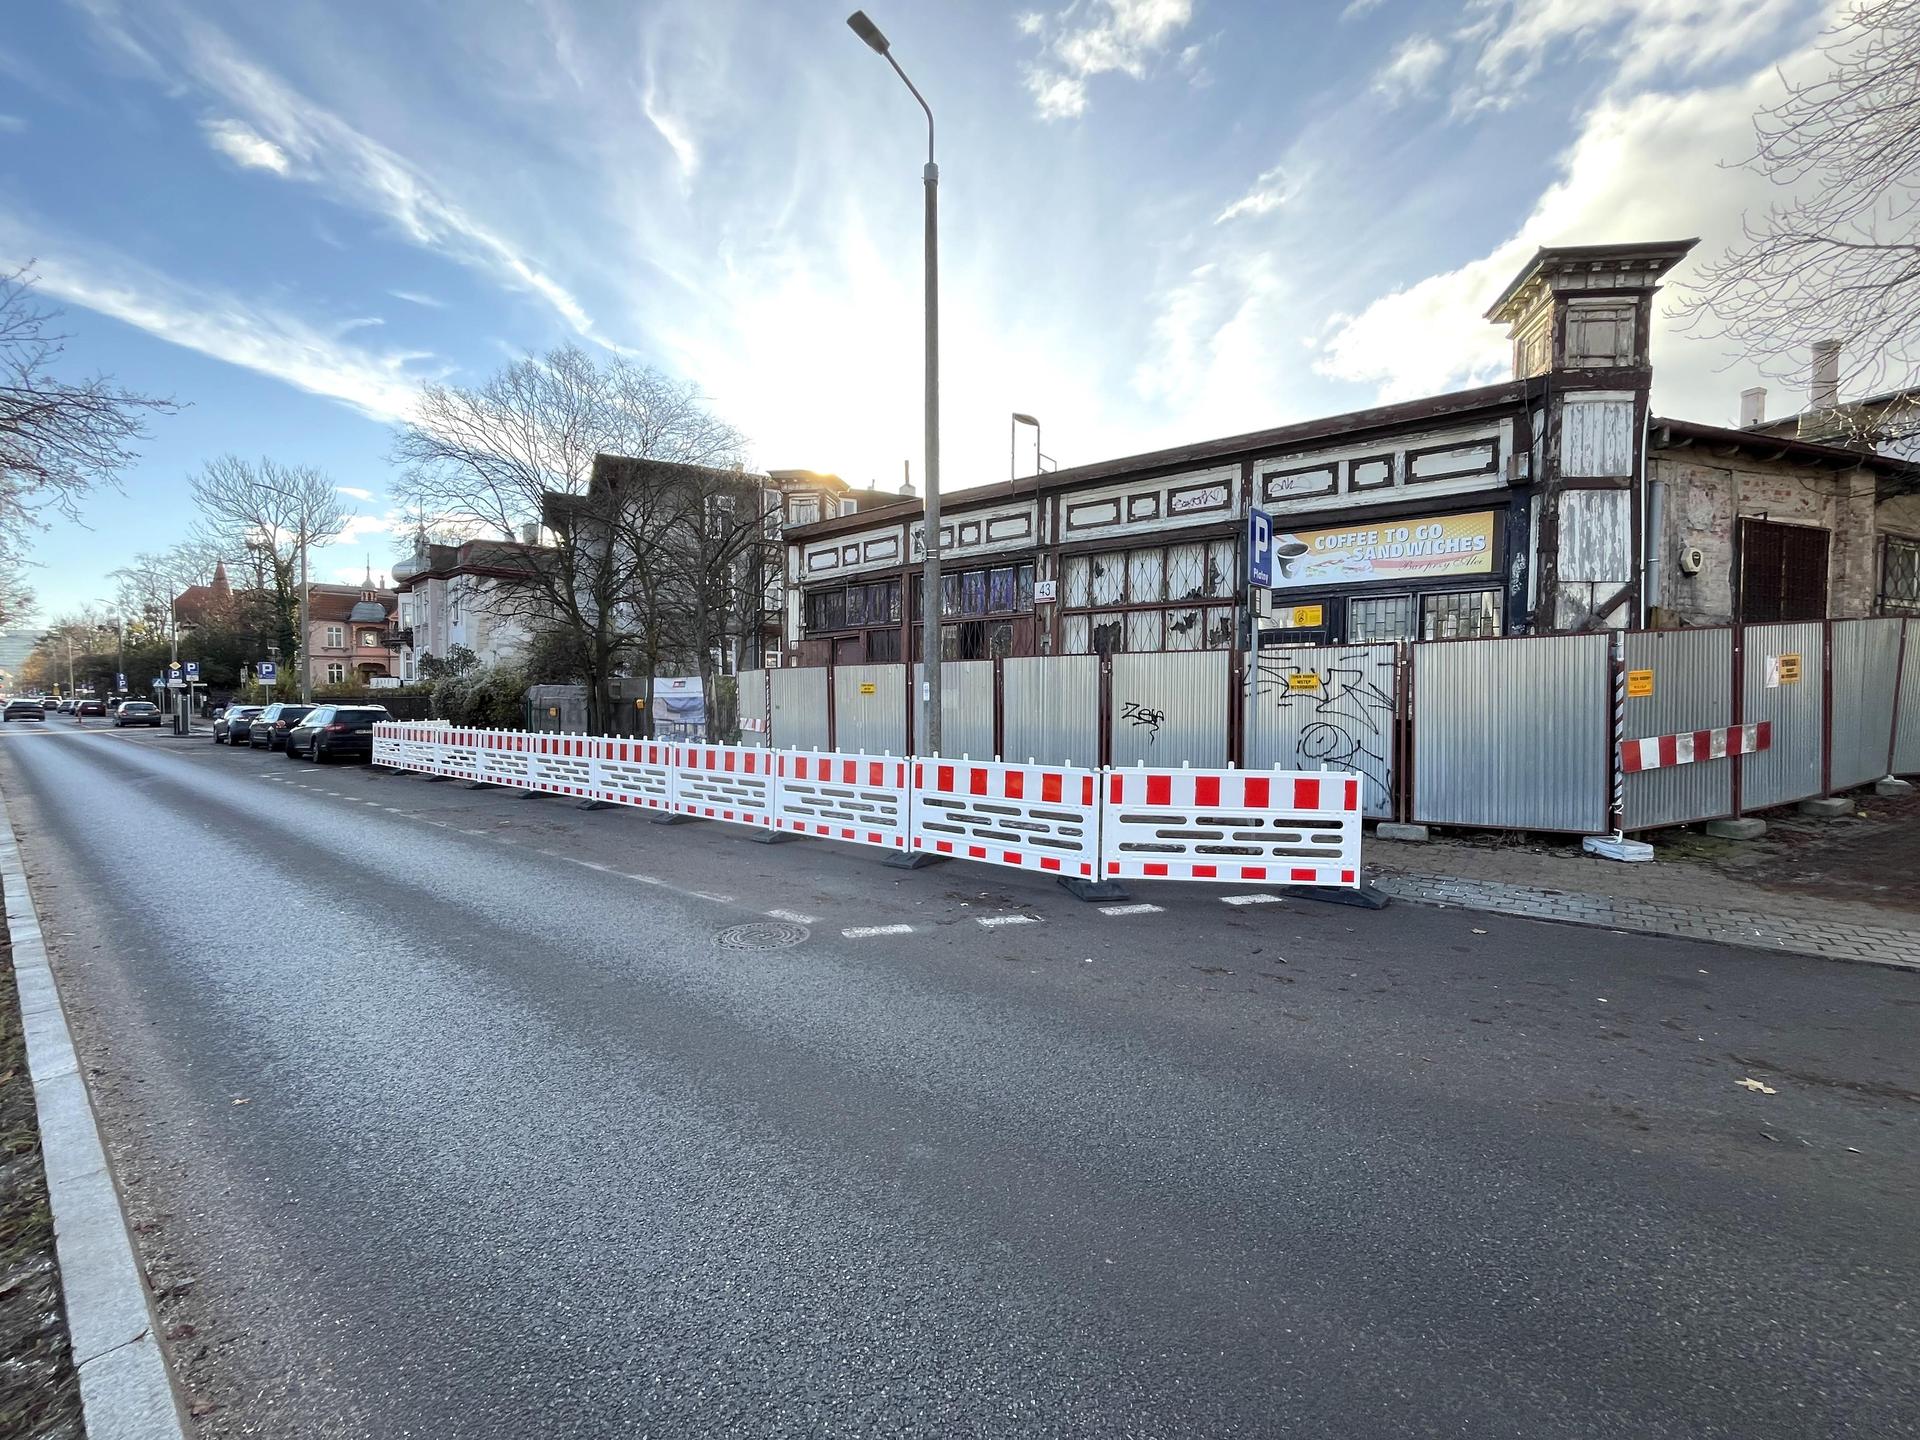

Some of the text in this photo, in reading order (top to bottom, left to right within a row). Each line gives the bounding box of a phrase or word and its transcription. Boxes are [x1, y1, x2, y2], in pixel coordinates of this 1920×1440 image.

[1255, 515, 1269, 564] P
[1315, 523, 1444, 551] COFFEE TO GO
[1352, 535, 1487, 562] SANDWICHES
[1039, 583, 1051, 597] 43
[262, 664, 273, 675] P
